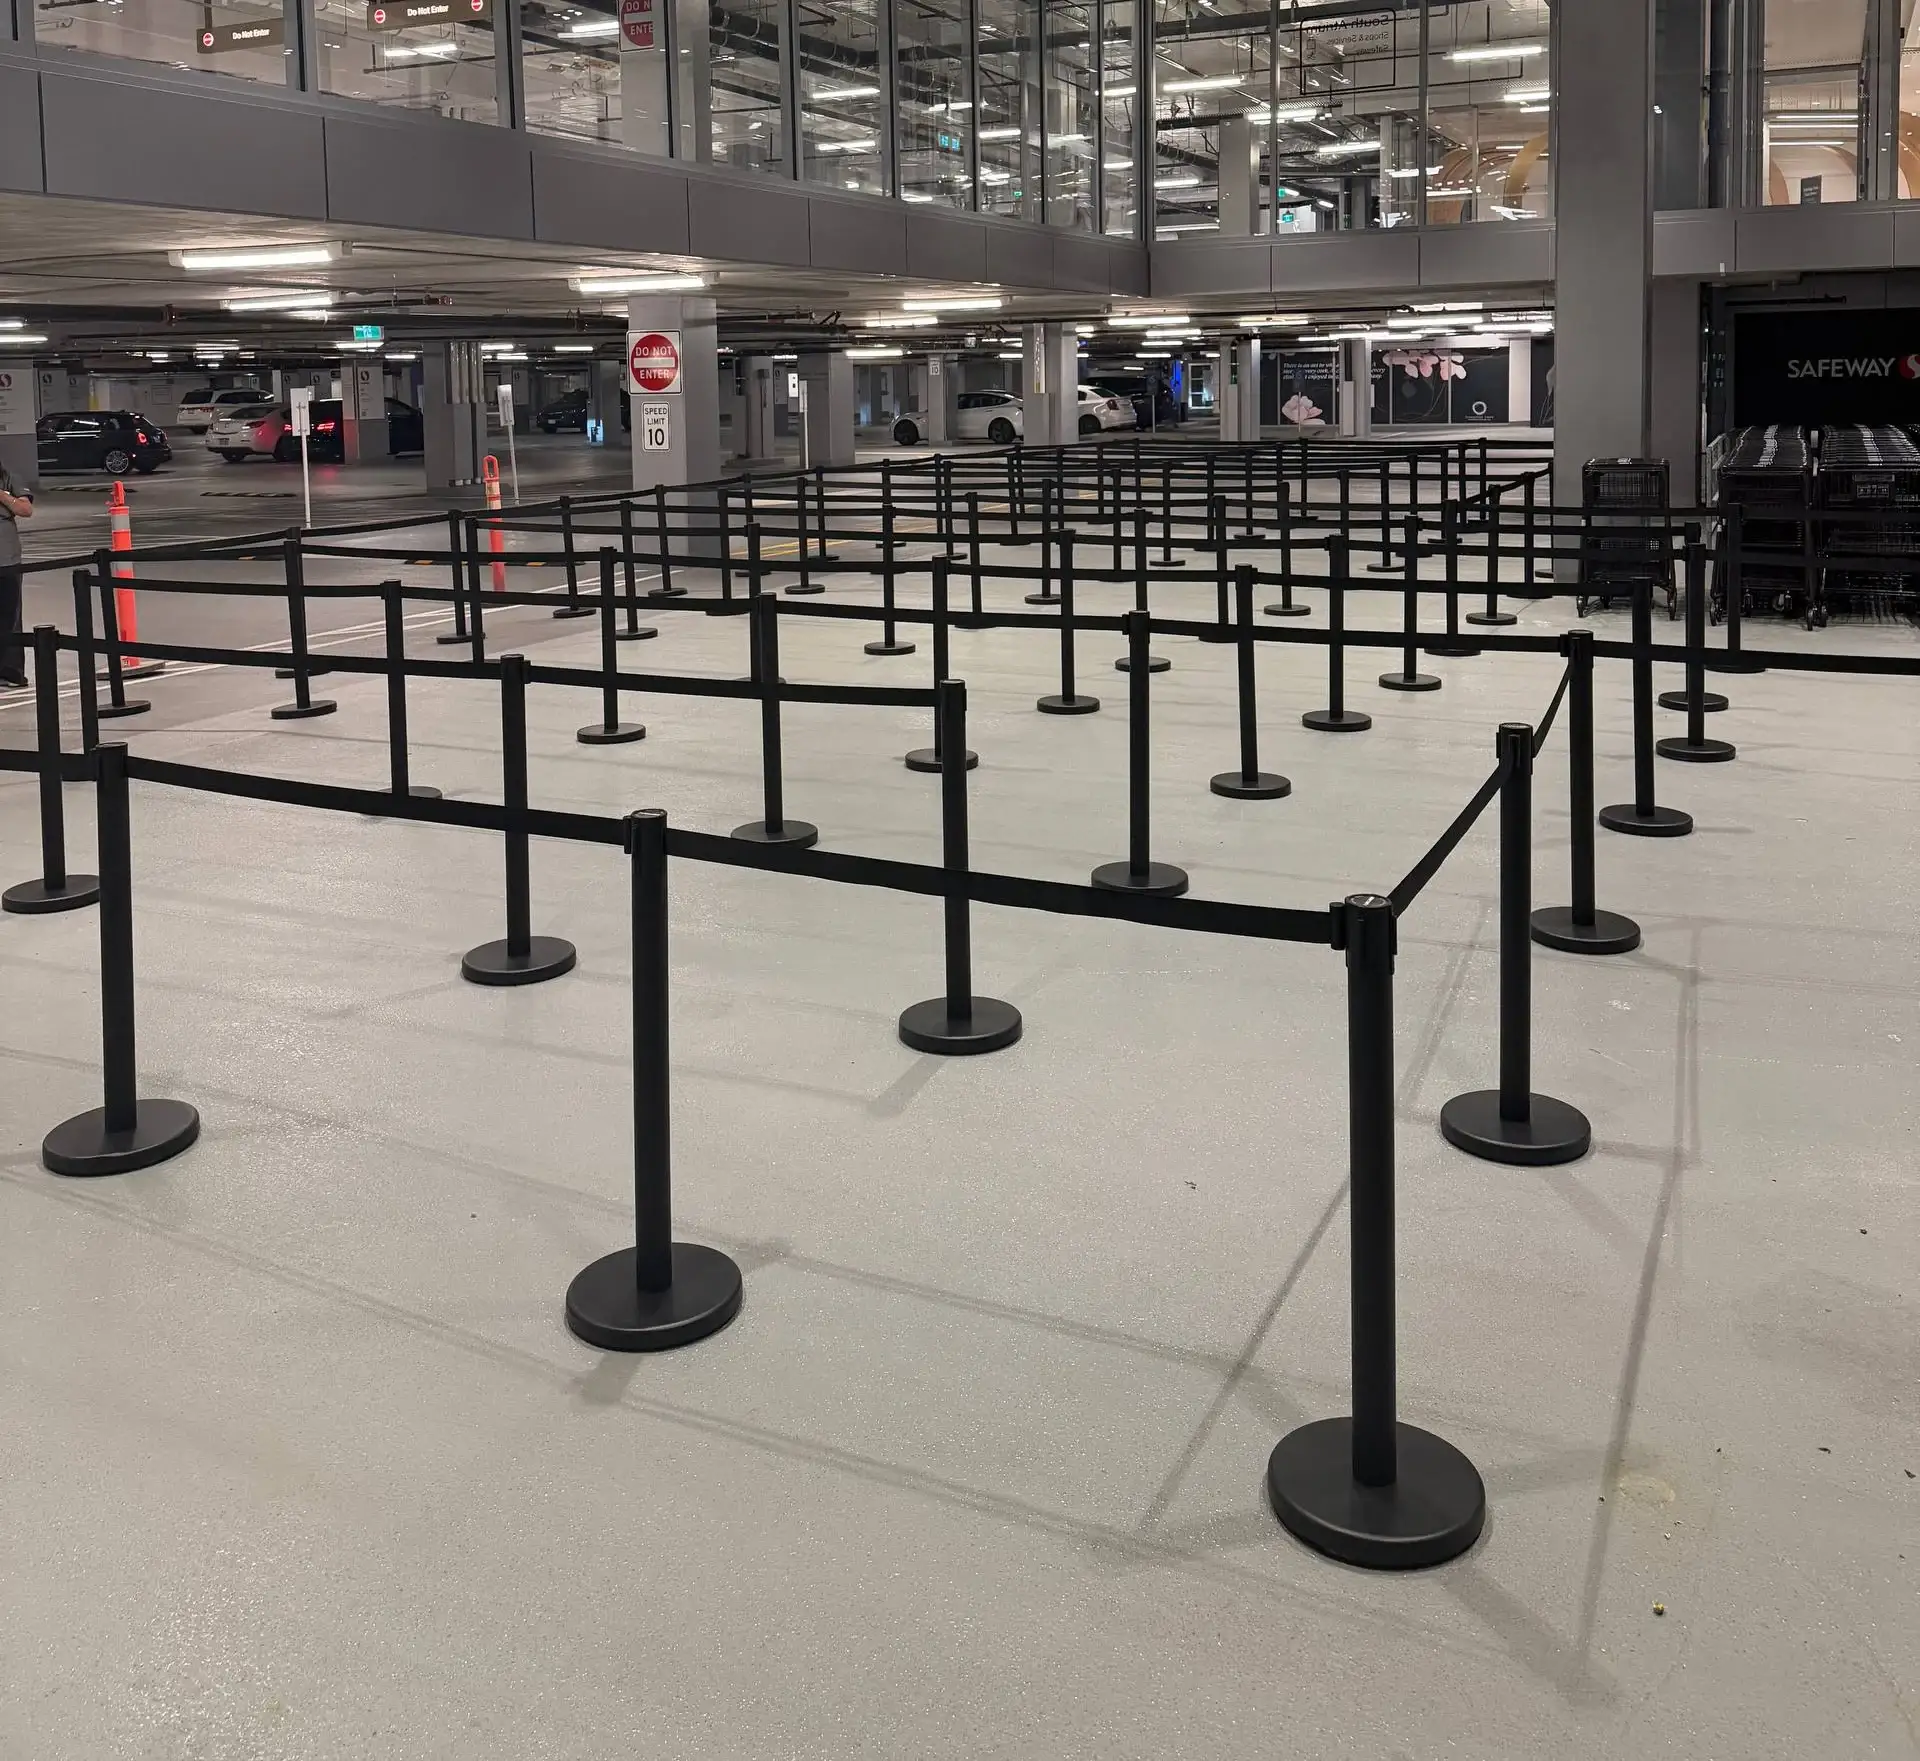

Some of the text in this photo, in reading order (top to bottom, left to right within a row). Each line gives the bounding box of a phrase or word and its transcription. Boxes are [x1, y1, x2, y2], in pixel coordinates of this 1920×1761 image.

[407, 5, 449, 16] Do Not Enter
[626, 1, 640, 12] DO
[232, 28, 270, 40] Do Not Enter
[630, 23, 654, 35] ENTE
[635, 345, 673, 356] DO NOT
[1787, 357, 1896, 379] SAFEWAY
[640, 369, 670, 379] ENTER
[644, 407, 667, 415] SPEED
[648, 428, 665, 446] 10
